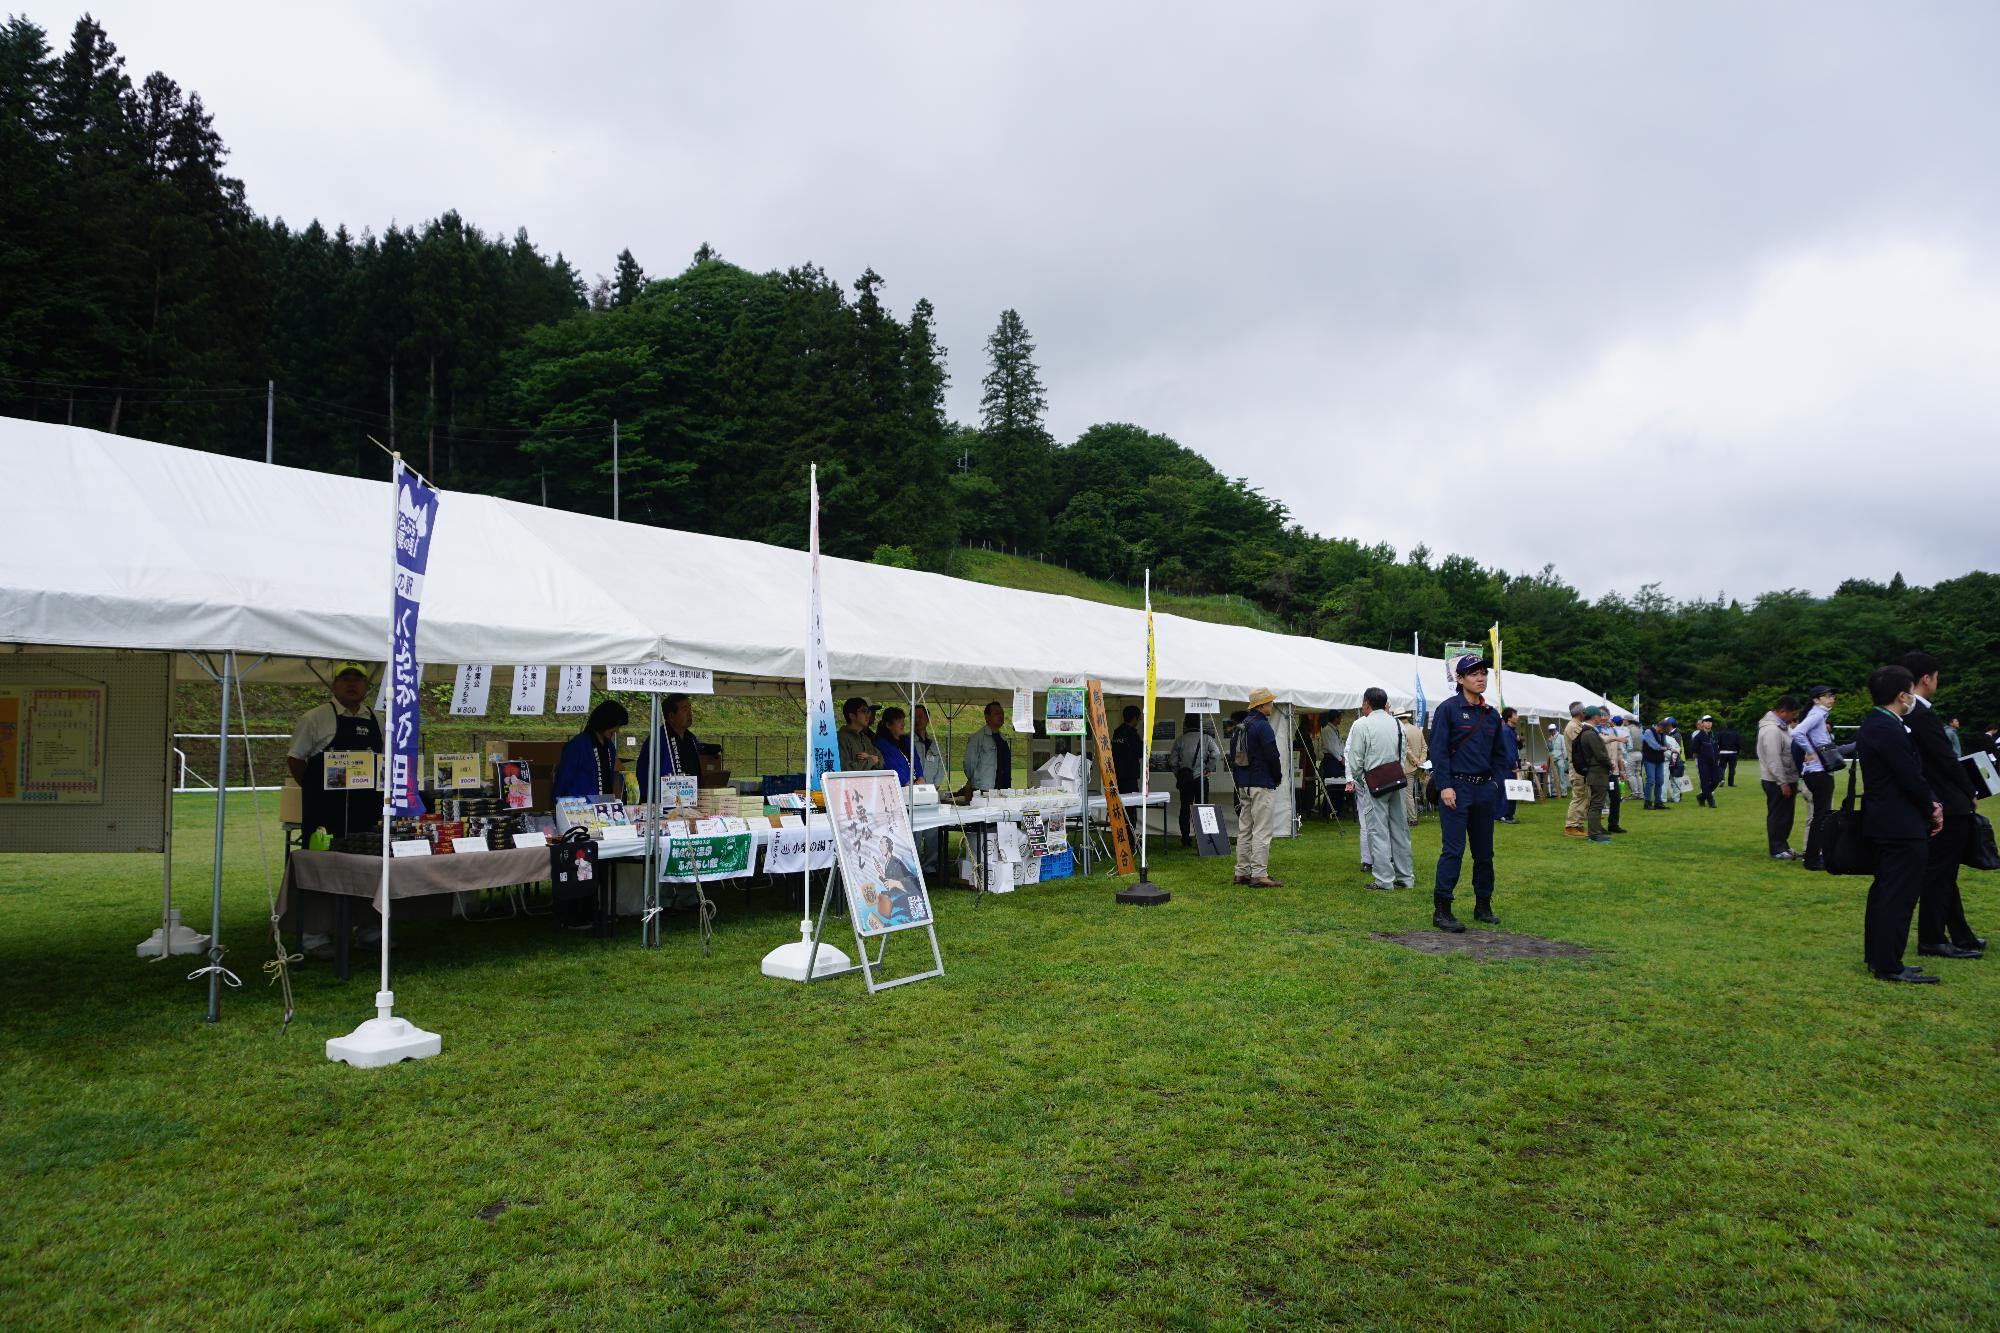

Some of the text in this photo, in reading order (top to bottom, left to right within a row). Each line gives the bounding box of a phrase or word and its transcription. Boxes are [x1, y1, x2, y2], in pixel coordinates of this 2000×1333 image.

[473, 665, 482, 688] 小栗公
[611, 667, 628, 675] 道の駅
[851, 789, 873, 841] 小栗公
